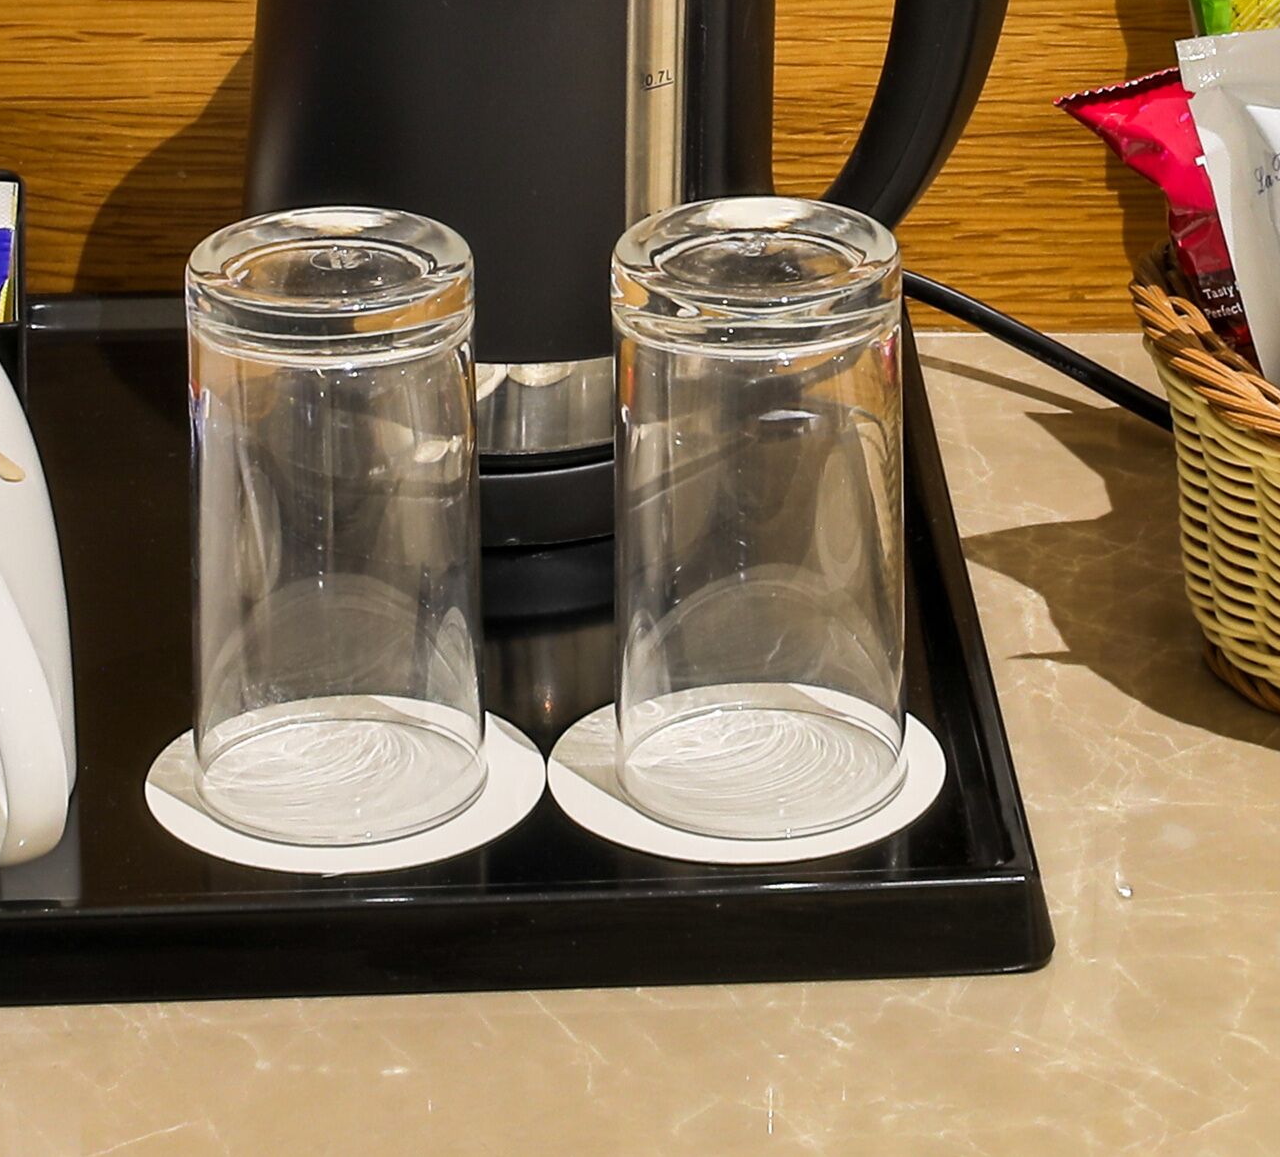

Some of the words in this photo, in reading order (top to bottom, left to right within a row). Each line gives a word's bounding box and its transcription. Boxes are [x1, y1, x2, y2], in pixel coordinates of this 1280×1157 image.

[645, 69, 673, 87] 0.7L
[1202, 285, 1236, 299] Tasty
[1204, 302, 1244, 319] Perfect
